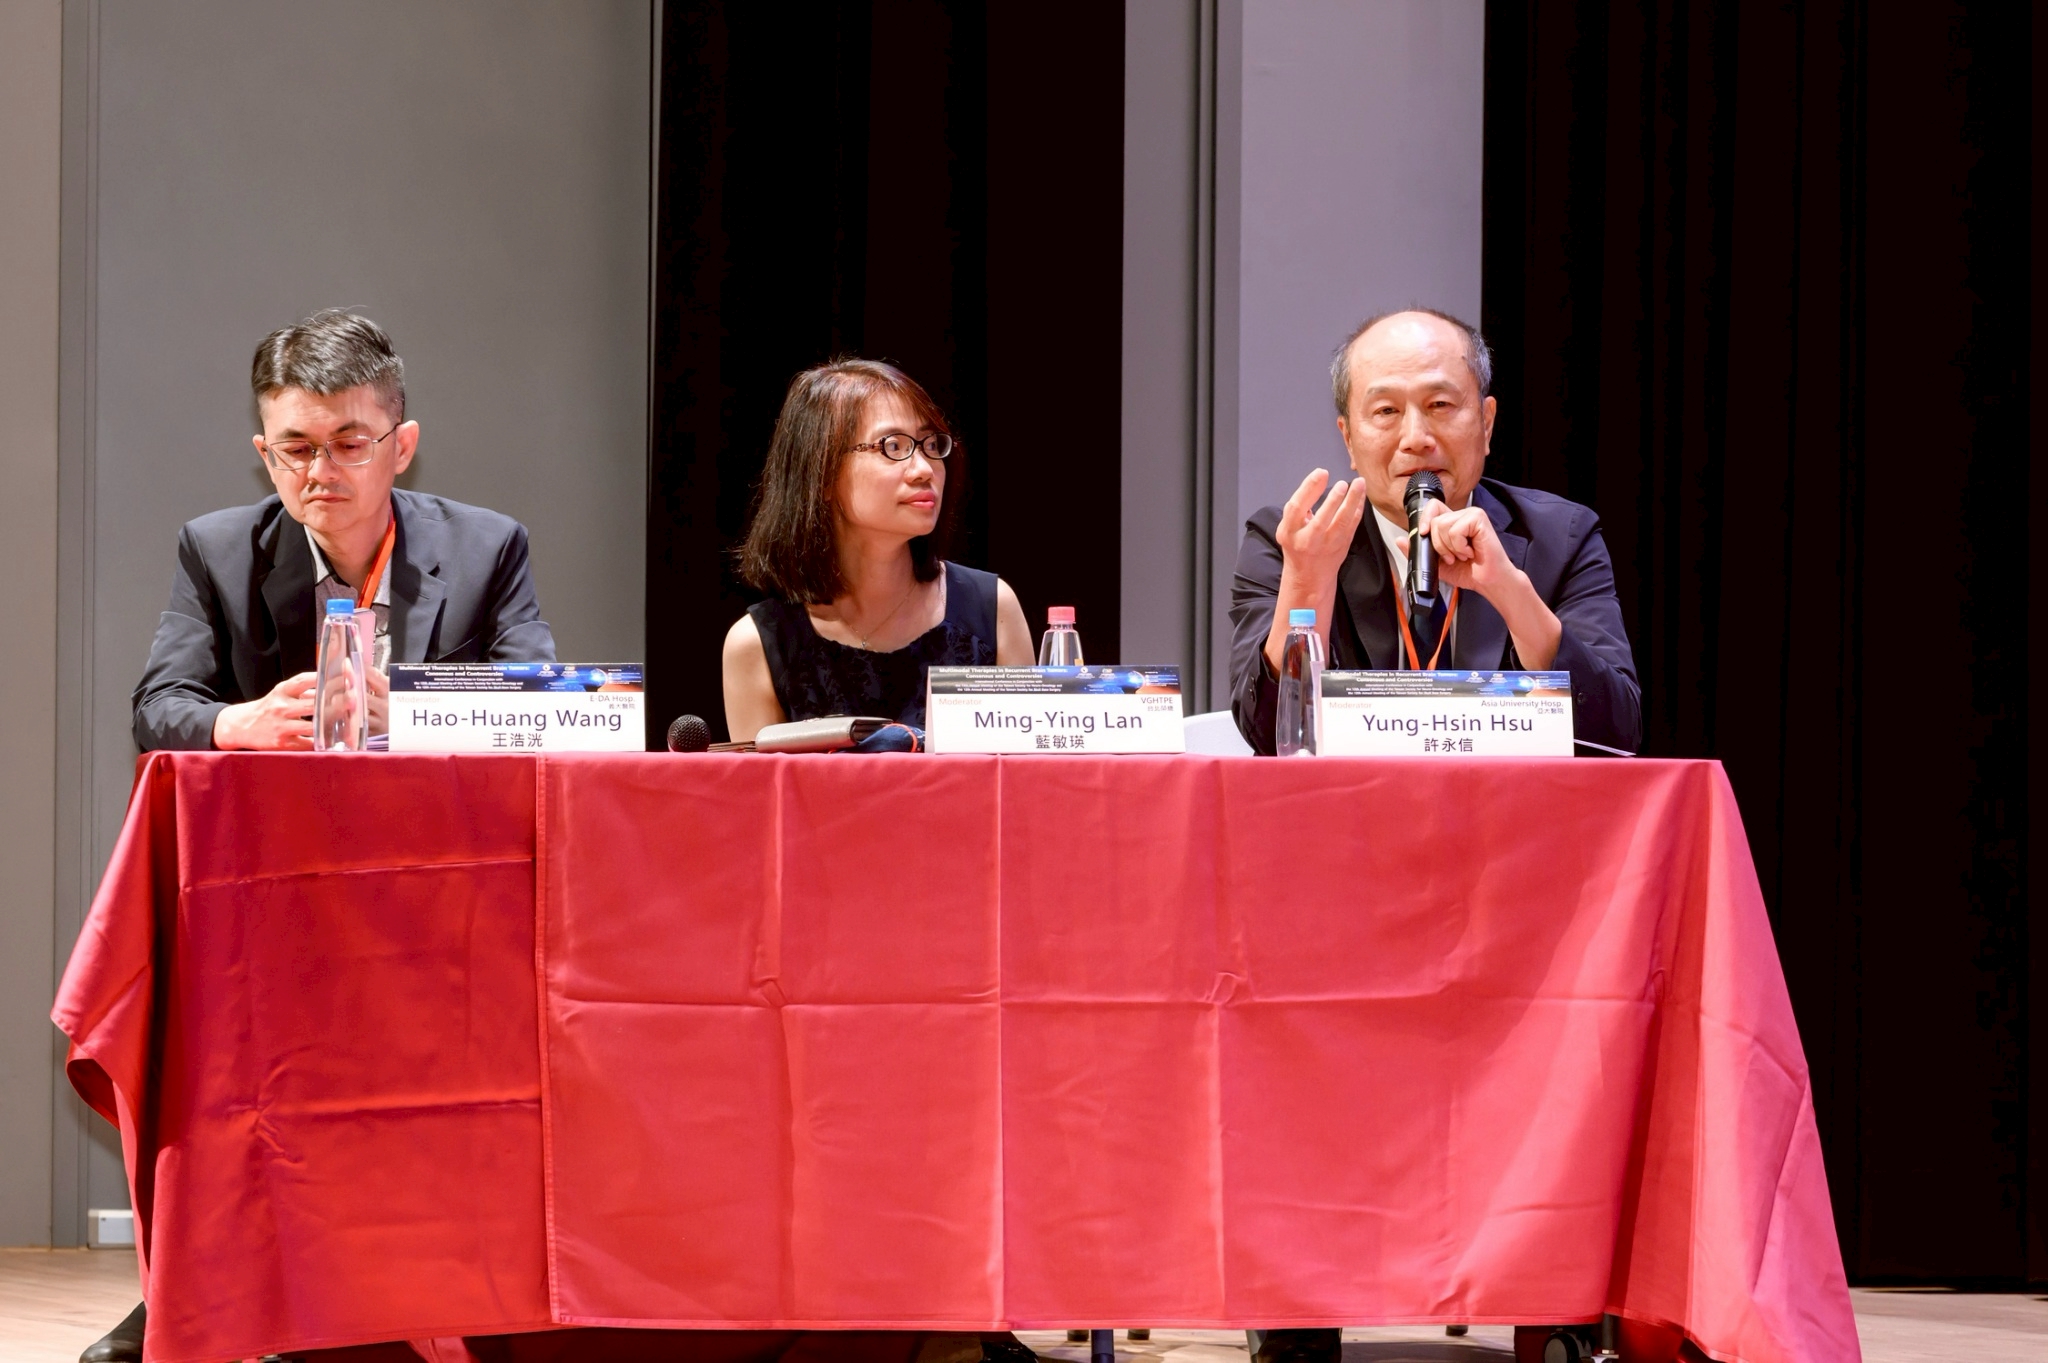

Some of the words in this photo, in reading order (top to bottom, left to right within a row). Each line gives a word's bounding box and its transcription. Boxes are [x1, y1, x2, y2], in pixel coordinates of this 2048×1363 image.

[396, 696, 440, 704] Moderator
[612, 695, 636, 704] Hosp.
[939, 698, 982, 706] Moderator
[1499, 700, 1538, 709] University
[1540, 700, 1564, 709] Hosp.
[413, 709, 547, 731] Hao-Huang
[556, 709, 621, 731] Wang
[975, 711, 1095, 733] Ming-Ying
[1104, 711, 1142, 729] Lan
[1362, 714, 1481, 736] Yung-Hsin
[1491, 714, 1533, 731] Hsu
[492, 733, 543, 747] 王浩洸
[1035, 735, 1085, 749] 藍敏瑛
[1424, 738, 1473, 752] 許永信
